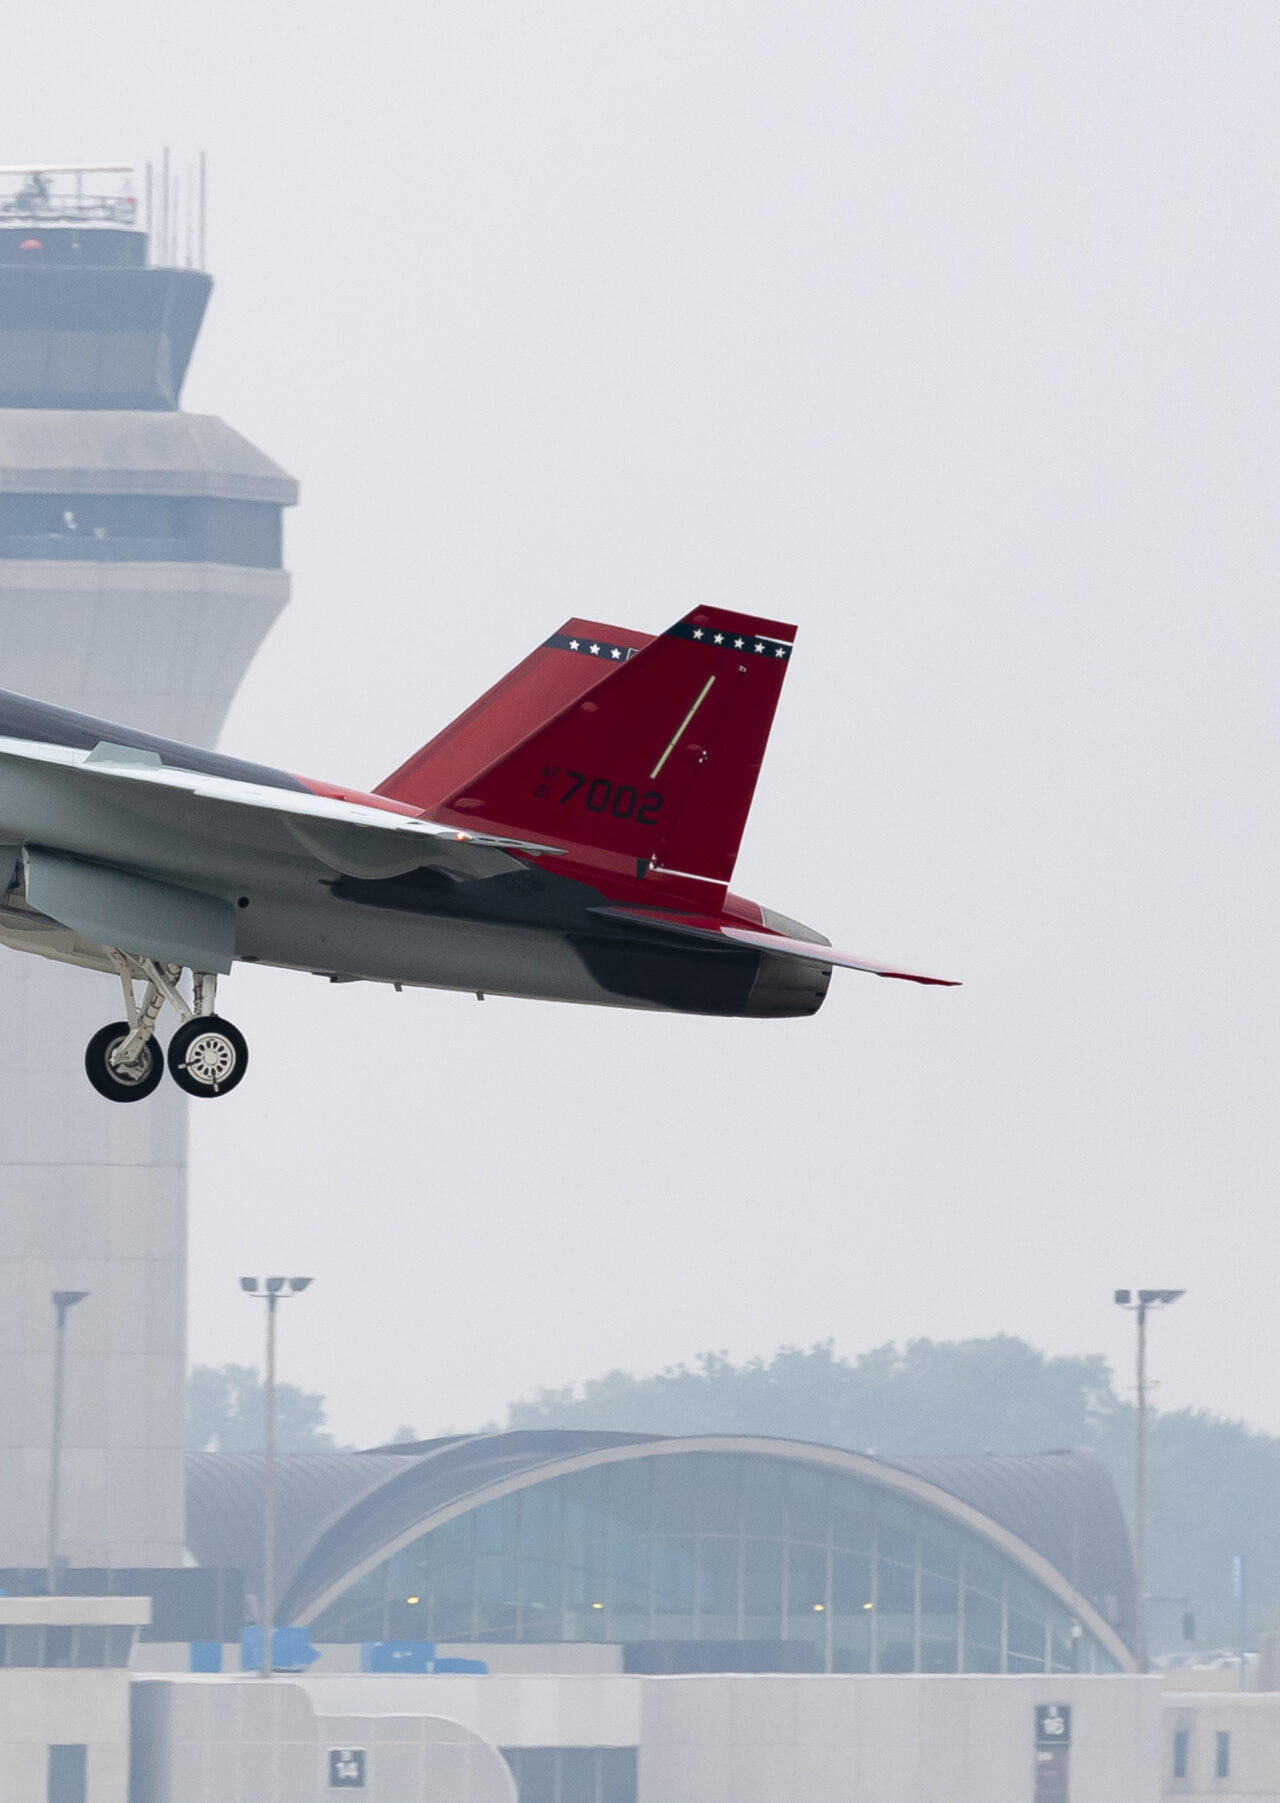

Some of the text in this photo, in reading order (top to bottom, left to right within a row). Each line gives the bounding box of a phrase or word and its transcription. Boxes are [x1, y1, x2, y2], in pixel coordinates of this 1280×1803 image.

[541, 764, 562, 780] AF
[534, 783, 551, 799] 21
[560, 770, 663, 826] 7002
[1042, 1717, 1064, 1735] 16
[335, 1761, 358, 1779] 14
